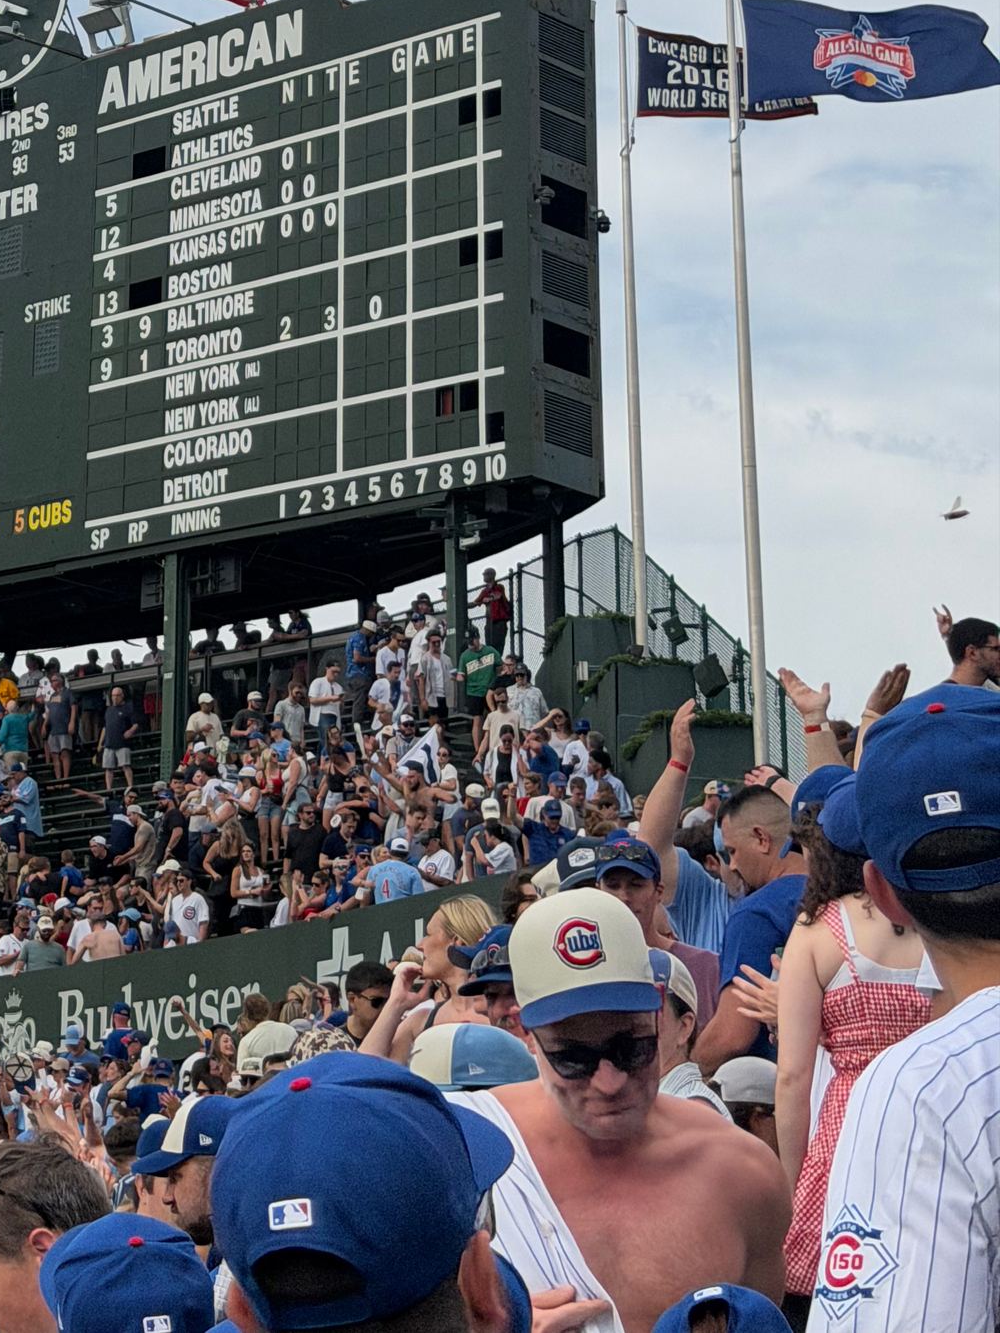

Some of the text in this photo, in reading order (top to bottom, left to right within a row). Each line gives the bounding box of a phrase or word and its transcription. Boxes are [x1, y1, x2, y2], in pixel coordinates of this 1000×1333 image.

[98, 9, 303, 115] AMERICAN
[648, 36, 707, 64] CHICAGO
[826, 37, 905, 67] ALL-STAR GAME
[667, 59, 730, 92] 2016
[172, 95, 239, 135] SEATTLE
[648, 88, 696, 109] WORLD
[11, 138, 31, 154] 2ND
[57, 124, 77, 140] 3RD
[171, 124, 253, 169] ATHLETICS
[13, 155, 28, 176] 93
[58, 141, 75, 163] 53
[105, 194, 117, 217] 5
[170, 155, 262, 200] CLEVELAND
[282, 146, 294, 171] 0
[100, 174, 315, 252] 12 MINNESOTA 0 0
[103, 202, 336, 282] 4 KANSAS CITY 0 0 0
[98, 261, 232, 316] 13 BOSTON
[24, 294, 71, 323] STRIKE
[101, 290, 254, 348] 3 9 BALTIMORE
[100, 295, 382, 381] 9 1 TORONTO 2 3 0
[165, 371, 196, 400] NEW
[200, 362, 240, 391] YORK
[164, 395, 260, 434] NEW YORK (AL)
[163, 428, 253, 469] COLORADO
[90, 527, 110, 551] SP
[128, 520, 149, 544] RP
[171, 506, 221, 536] INNING
[298, 489, 312, 515] 2
[321, 485, 335, 511] 3
[344, 481, 358, 506] 4
[368, 476, 381, 502] 5
[390, 472, 404, 498] 6
[415, 467, 428, 494] 7
[438, 463, 453, 489] 8
[462, 458, 477, 485] 9
[485, 453, 507, 482] 10
[163, 468, 229, 504] DETROIT
[14, 509, 25, 533] 5
[28, 499, 72, 531] CUBS
[382, 879, 390, 898] 4
[833, 1254, 863, 1270] 150
